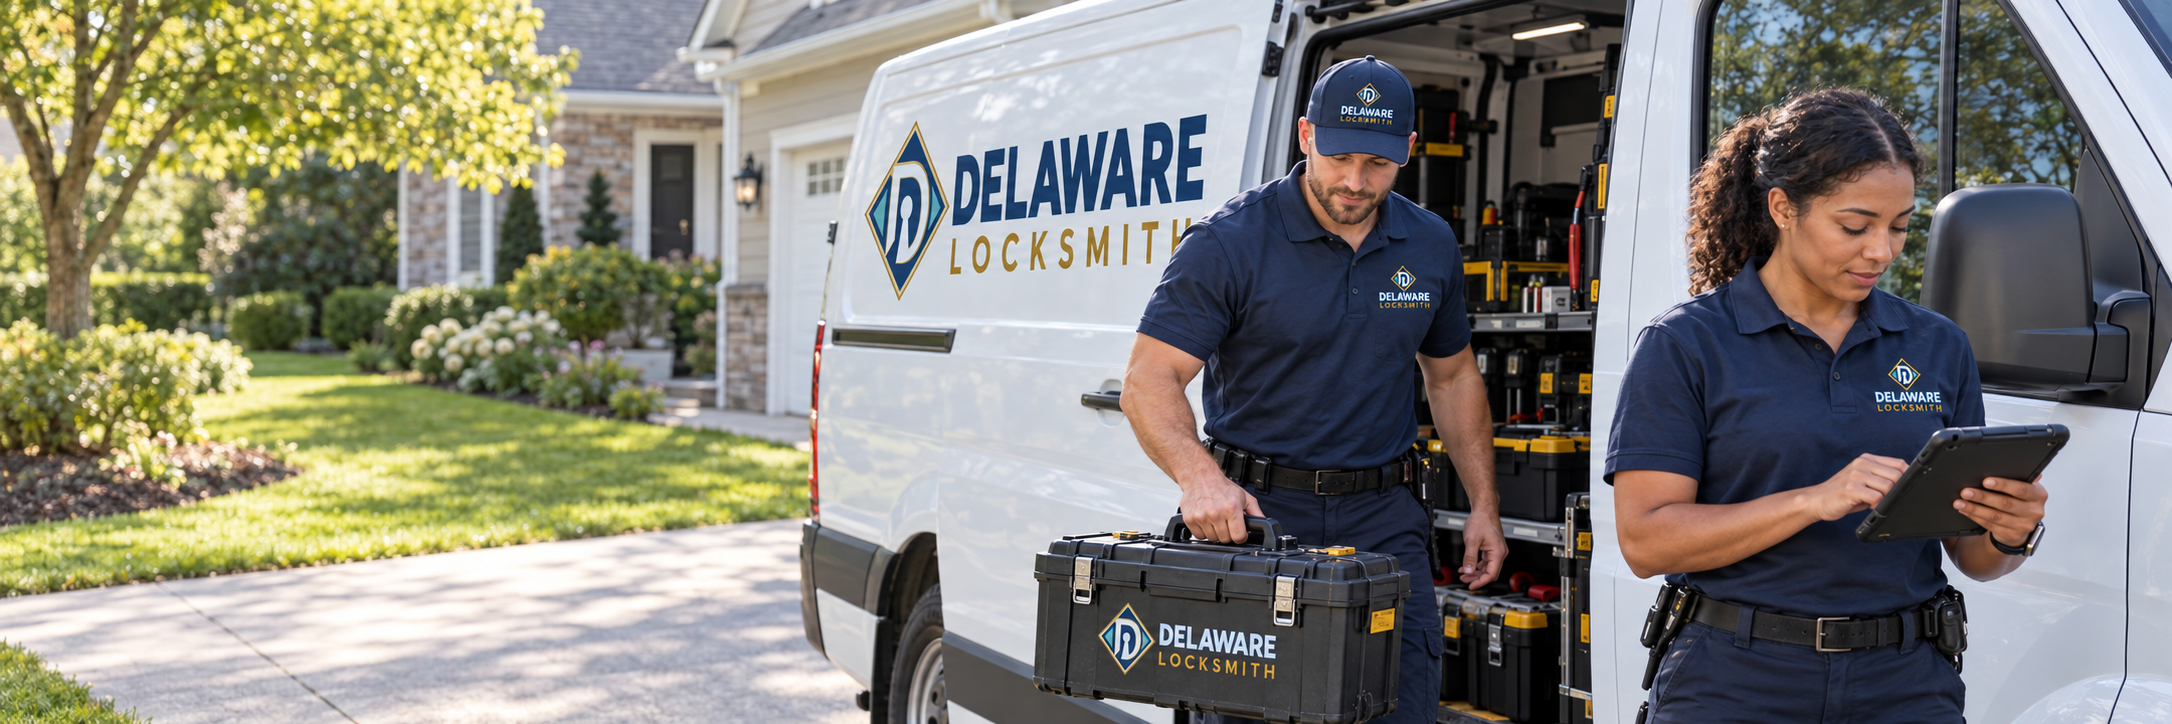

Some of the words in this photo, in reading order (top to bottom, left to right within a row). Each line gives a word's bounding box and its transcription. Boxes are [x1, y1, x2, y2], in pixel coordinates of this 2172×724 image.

[1341, 105, 1394, 119] DELAWARE
[952, 114, 1207, 226] DELAWARE
[1379, 291, 1430, 302] DELAWARE
[1379, 301, 1431, 309] LOCKSMITH
[1874, 391, 1942, 403] DELAWARE
[1876, 403, 1943, 413] LOCKSMITH
[1159, 622, 1277, 660] DELAWARE
[1158, 651, 1276, 680] LOCKSMITH
